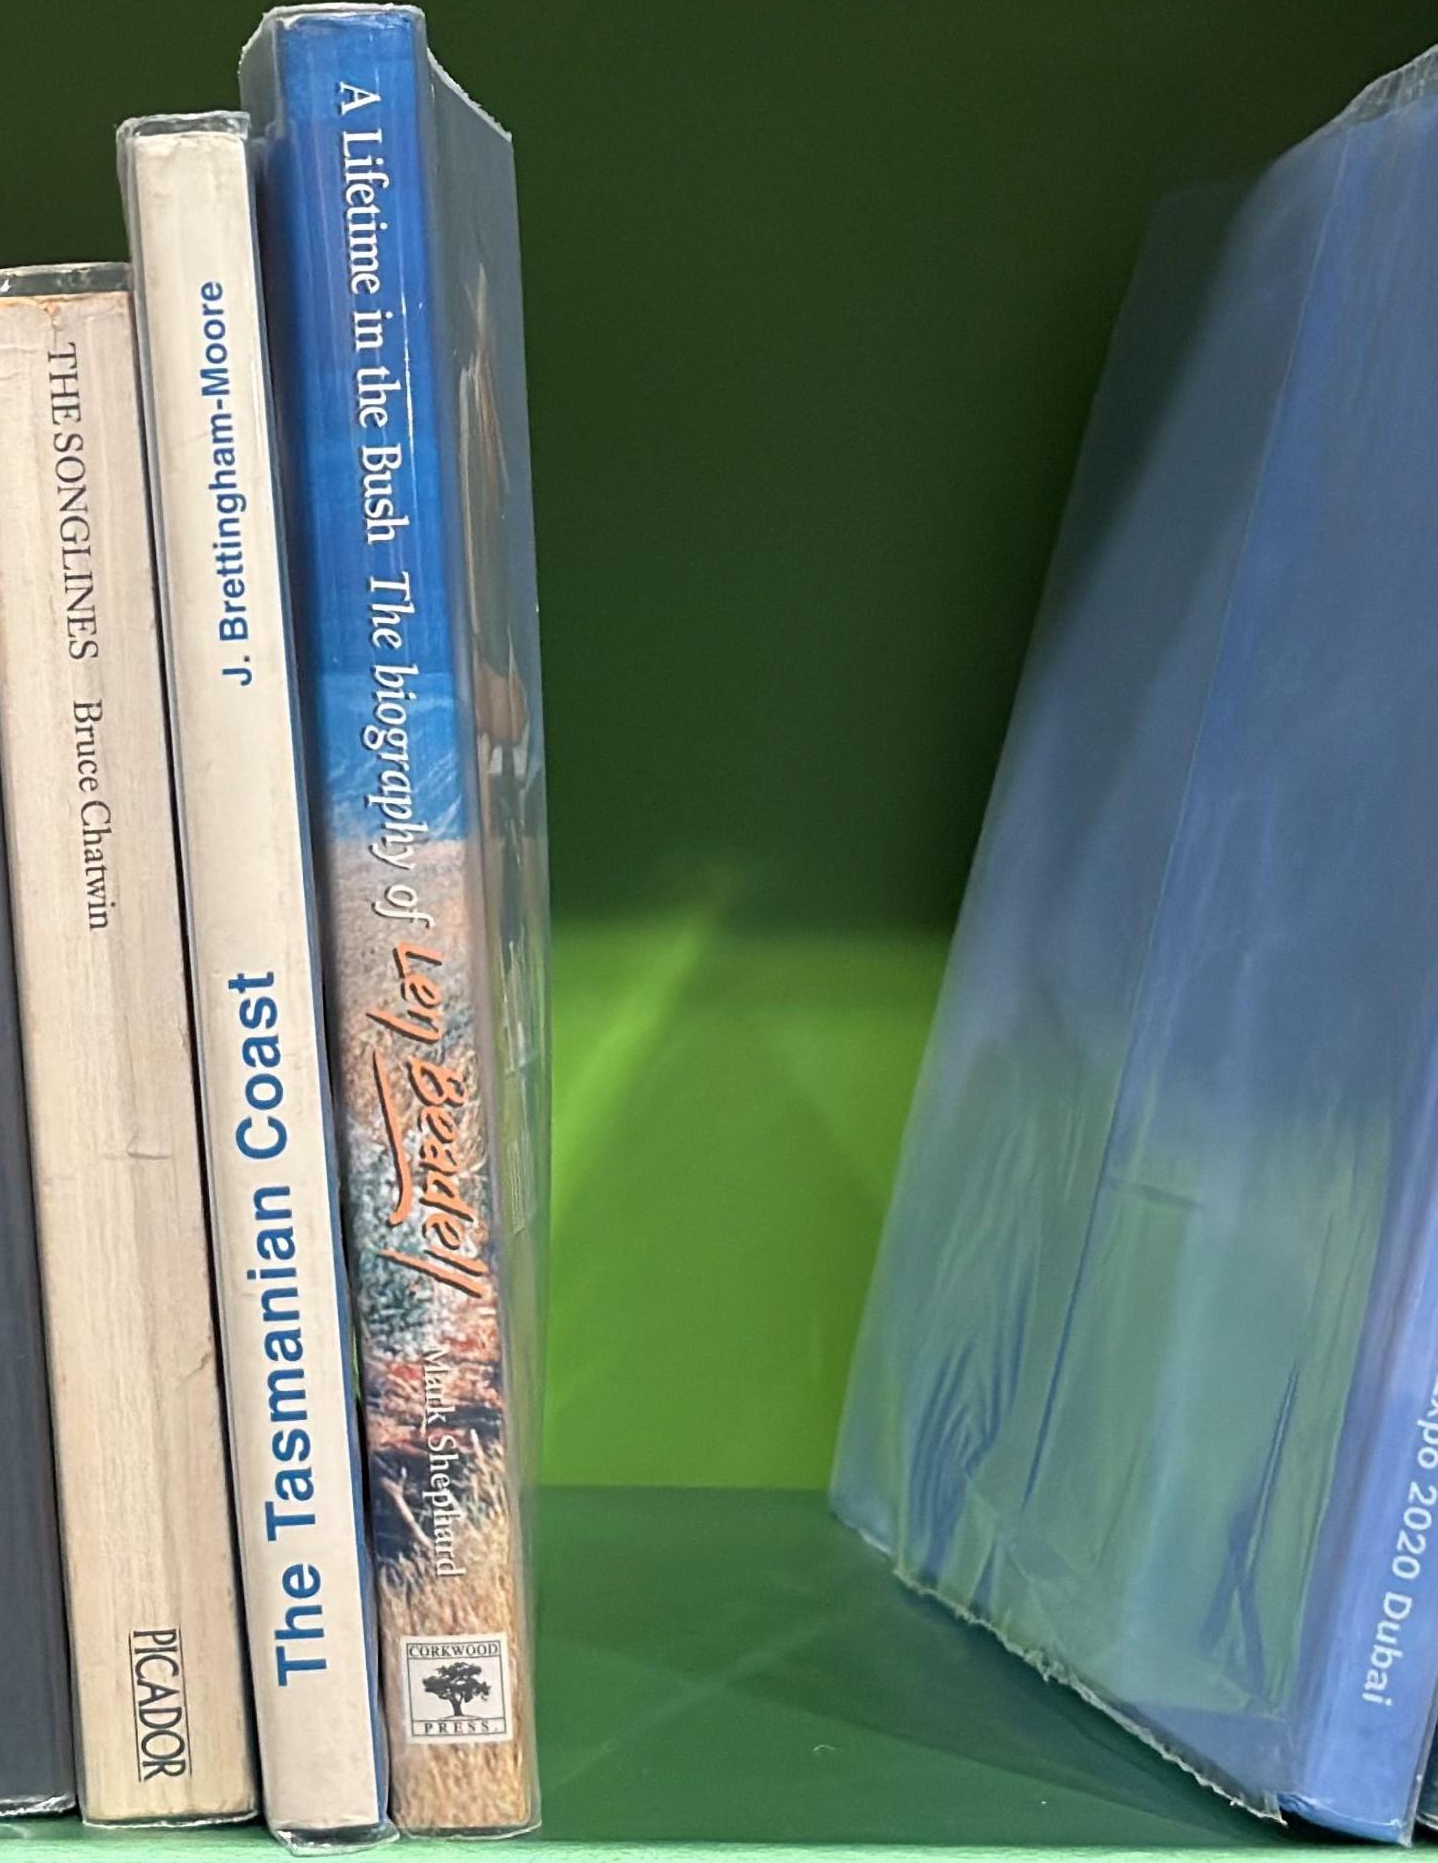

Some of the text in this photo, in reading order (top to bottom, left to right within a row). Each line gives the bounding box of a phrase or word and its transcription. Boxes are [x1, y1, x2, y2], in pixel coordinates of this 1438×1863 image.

[199, 280, 254, 688] J. Brettingham-Moore
[337, 81, 446, 1044] A Lifetime in the Bush The biography of Len
[46, 340, 111, 931] THE SONGLINES Bruce Chatwin
[226, 970, 326, 1686] The Tasmanian Coast
[421, 1433, 467, 1579] Shephard
[128, 1627, 190, 1785] PICADOR
[407, 1642, 500, 1659] CORKWOOD
[1361, 1589, 1416, 1708] Dubai
